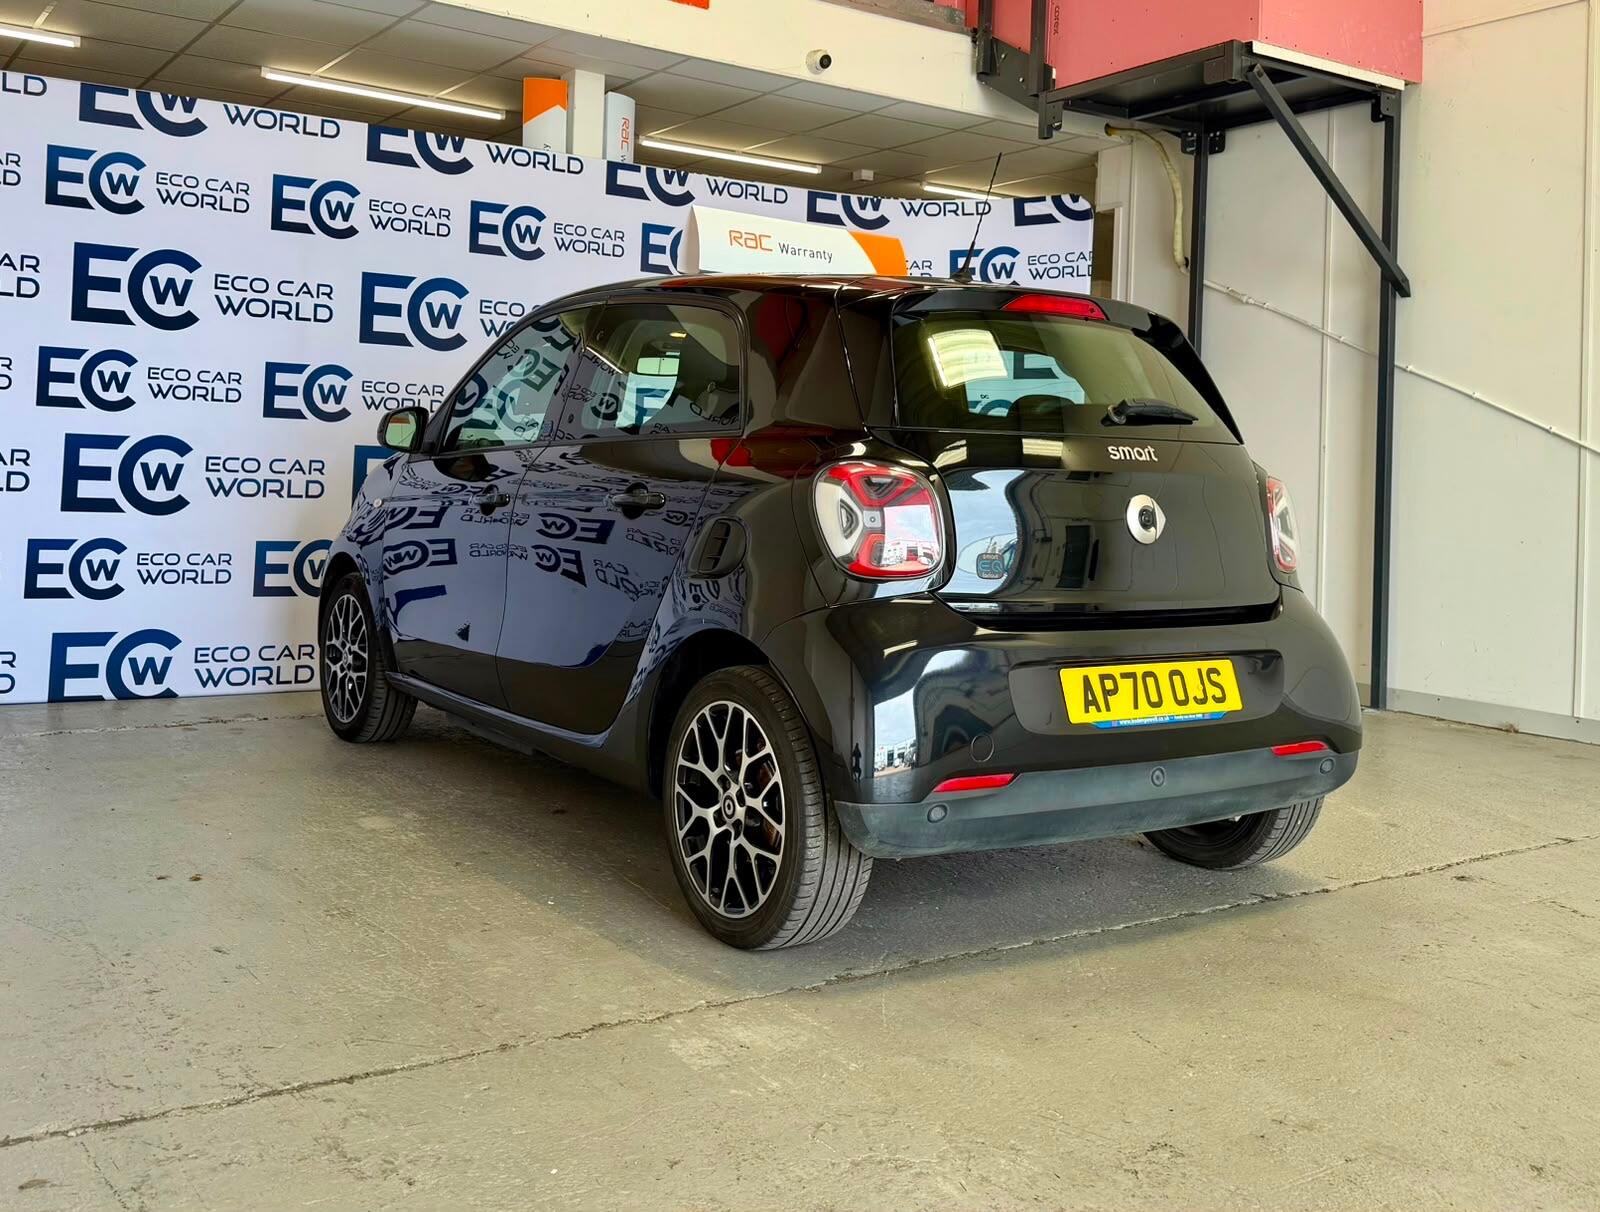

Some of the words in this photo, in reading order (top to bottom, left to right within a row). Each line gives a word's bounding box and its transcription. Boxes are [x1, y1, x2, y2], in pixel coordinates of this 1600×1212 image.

[223, 104, 340, 138] WORLD
[486, 144, 584, 174] WORLD
[45, 144, 146, 215] ECW
[156, 172, 199, 188] ECO
[205, 179, 249, 195] CAR
[706, 178, 788, 204] WORLD
[157, 188, 249, 213] WORLD
[271, 174, 360, 239] ECW
[369, 199, 407, 214] ECO
[412, 205, 450, 220] CAR
[901, 201, 991, 217] WORLD
[369, 214, 450, 237] WORLD
[469, 200, 546, 260] ECW
[554, 223, 586, 236] ECO
[591, 228, 624, 242] CAR
[554, 237, 624, 257] WORLD
[778, 242, 833, 262] Warranty
[1028, 255, 1061, 266] ECO
[1028, 265, 1093, 281] WORL
[71, 242, 202, 331] ECW
[214, 274, 269, 293] ECO
[277, 280, 333, 300] CAR
[215, 295, 333, 323] WORLD
[359, 272, 469, 351] ECW
[480, 300, 525, 317] ECO
[36, 346, 138, 412] ECW
[148, 367, 191, 381] ECO
[197, 371, 241, 385] CAR
[148, 383, 241, 403] WORLD
[263, 362, 353, 422] ECW
[362, 381, 400, 394] ECO
[405, 384, 444, 396] CAR
[1107, 445, 1158, 462] smart
[61, 433, 193, 516] ECW
[206, 456, 261, 473] ECO
[269, 459, 325, 475] CAR
[206, 477, 324, 499] WORLD
[24, 538, 127, 600] ECW
[137, 553, 180, 565] ECO
[187, 554, 231, 565] CAR
[137, 569, 231, 584] WORLD
[48, 628, 183, 702] ECW
[194, 646, 250, 663] ECO
[258, 644, 315, 661] CAR
[195, 664, 315, 688] WORLD
[1083, 671, 1163, 713] AP70
[1168, 667, 1227, 706] OJS
